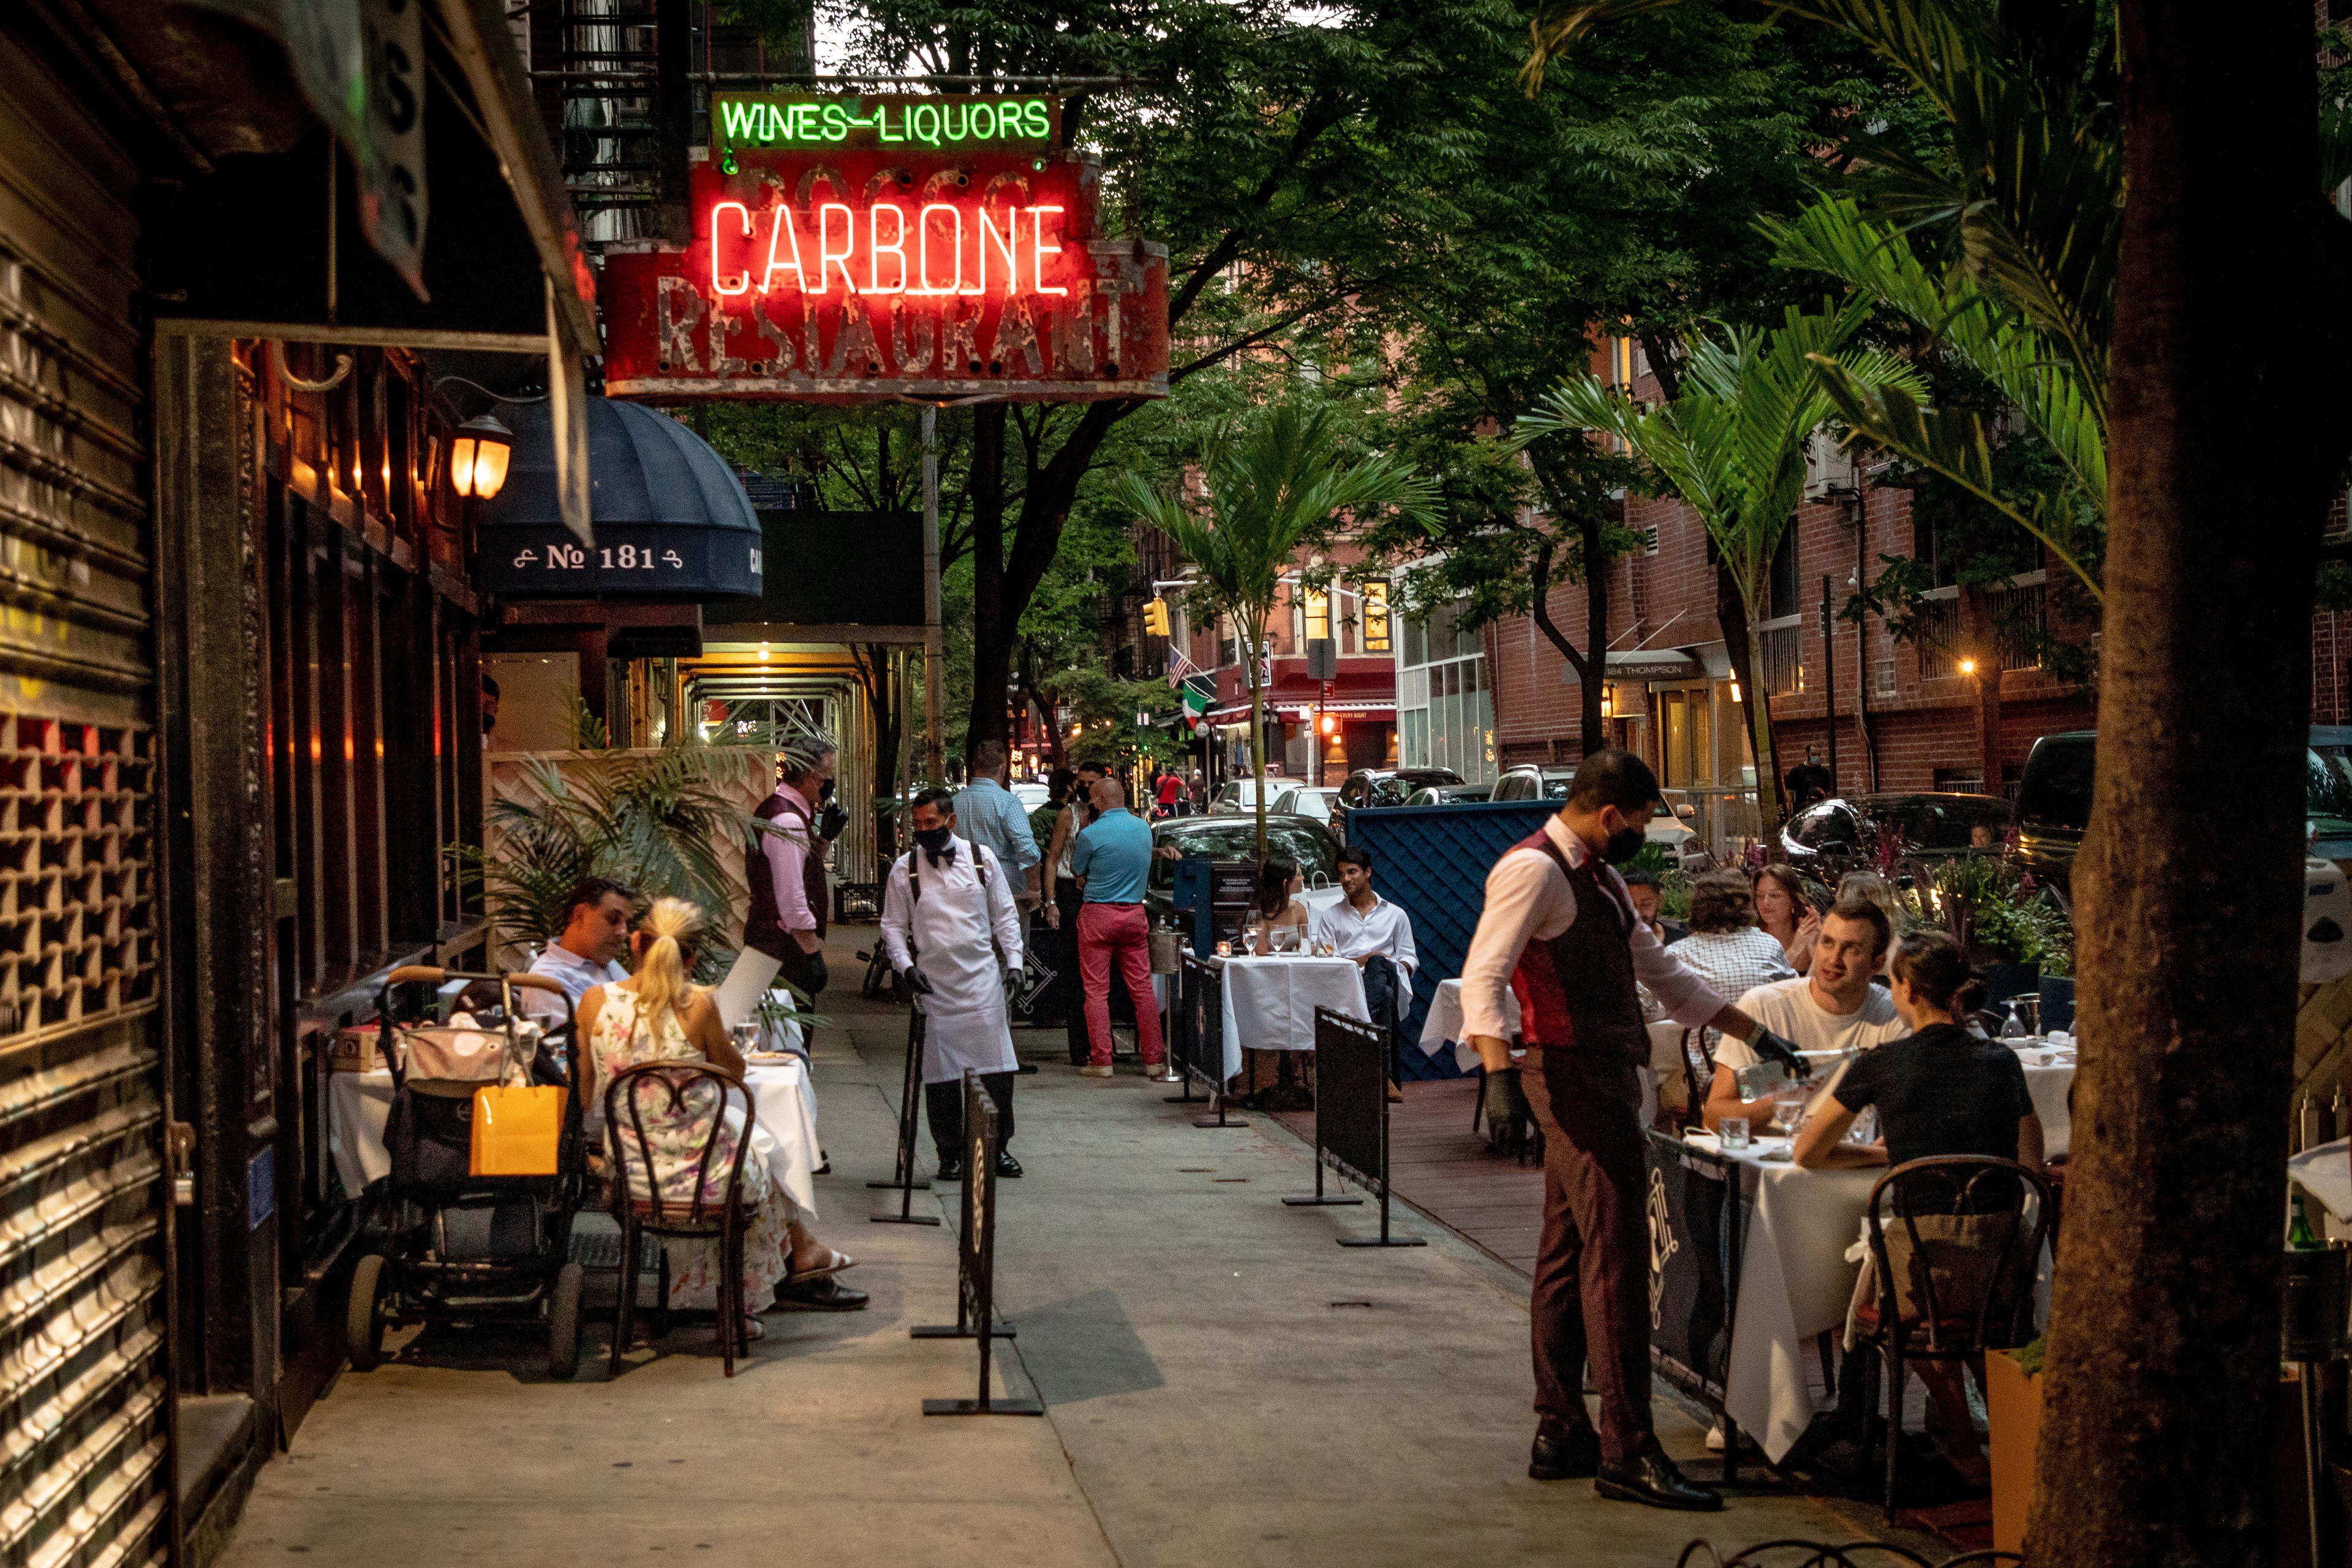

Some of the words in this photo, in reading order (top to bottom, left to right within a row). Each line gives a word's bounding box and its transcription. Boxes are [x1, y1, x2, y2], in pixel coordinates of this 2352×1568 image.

[710, 201, 1069, 296] CARBONE
[599, 544, 655, 569] 181
[1624, 666, 1681, 674] THOMPSON
